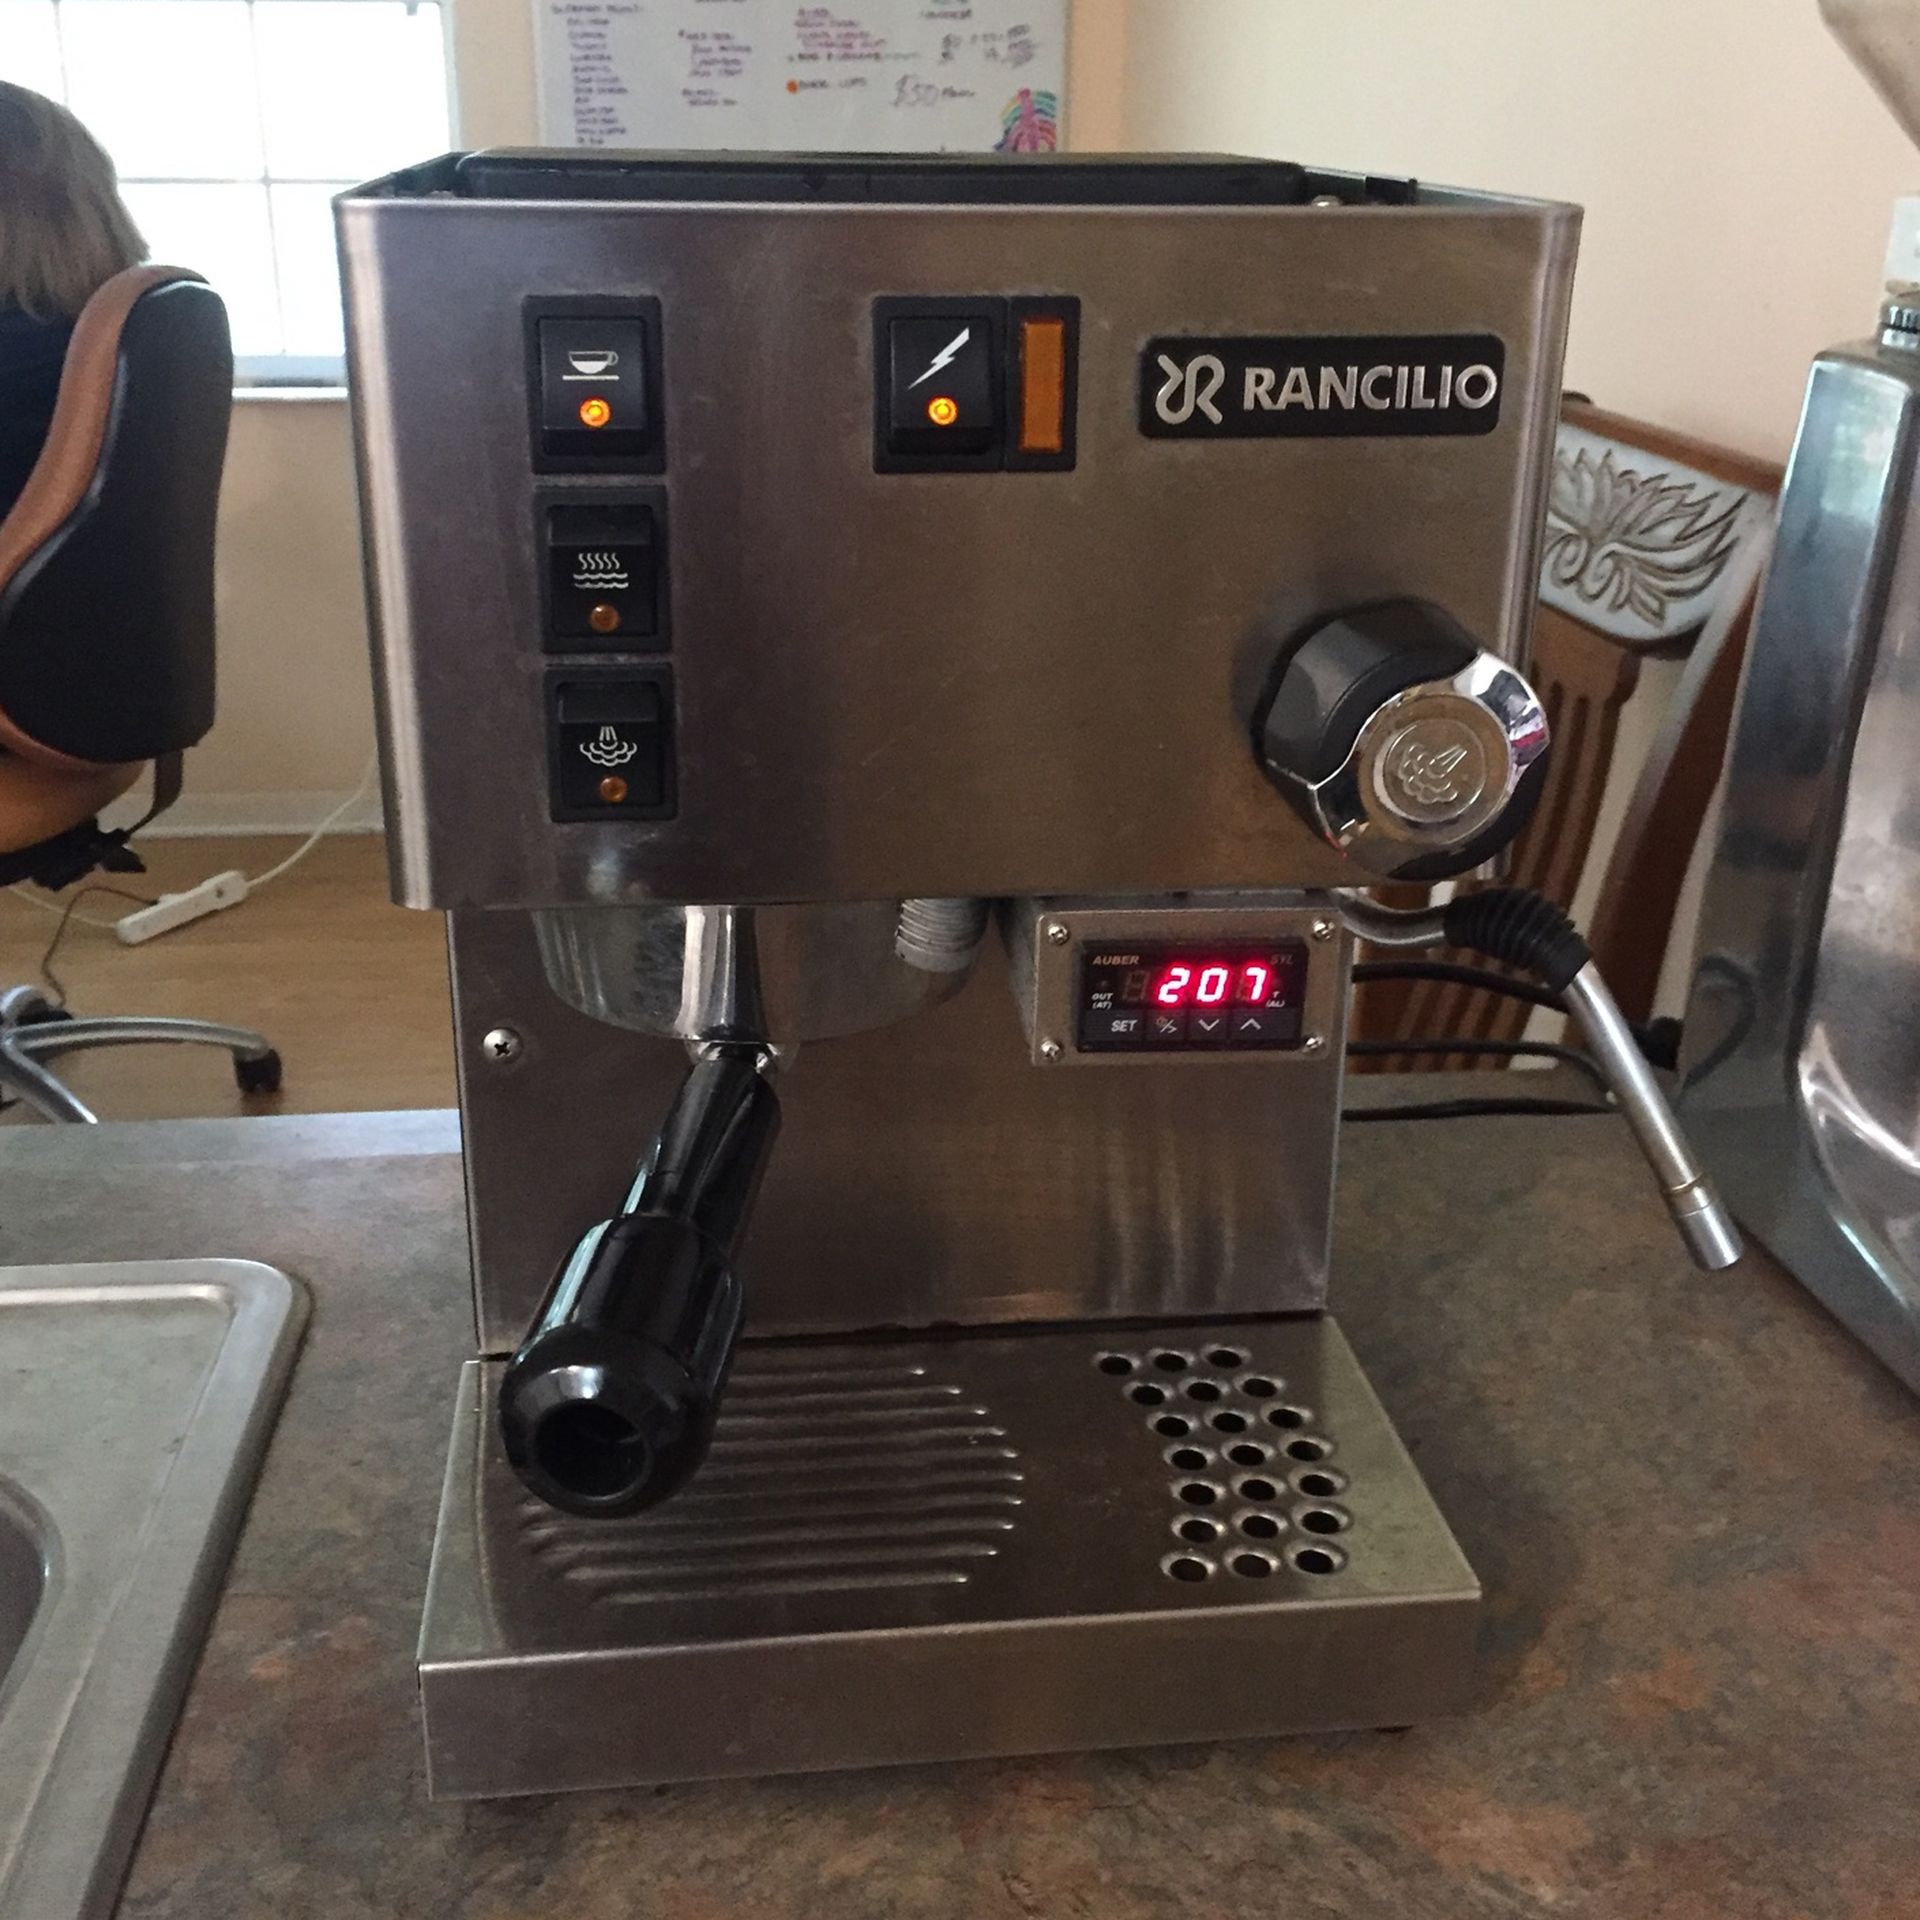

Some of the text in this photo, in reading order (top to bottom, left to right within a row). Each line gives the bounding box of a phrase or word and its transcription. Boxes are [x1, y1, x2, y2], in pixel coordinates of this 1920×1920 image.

[1243, 364, 1498, 411] RANCILIO
[1093, 955, 1140, 966] AUBER
[1157, 966, 1267, 1003] 207
[1092, 992, 1113, 1001] OUT
[1111, 1019, 1137, 1033] SET
